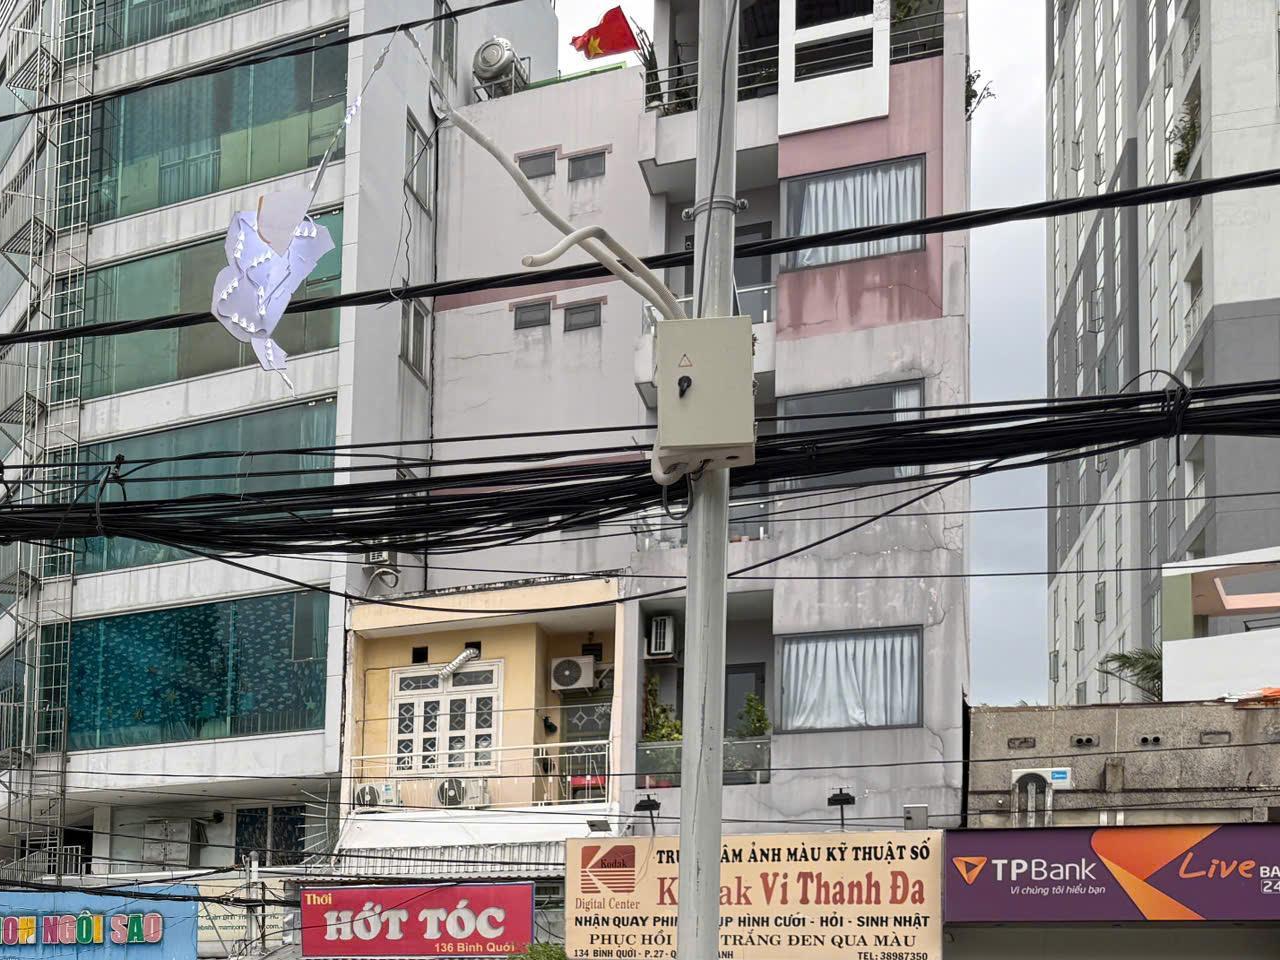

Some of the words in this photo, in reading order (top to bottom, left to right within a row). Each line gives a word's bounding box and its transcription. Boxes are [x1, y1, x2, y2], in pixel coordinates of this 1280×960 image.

[656, 850, 679, 864] TRU
[720, 844, 743, 863] ÂM
[747, 841, 782, 862] ẢNH
[787, 842, 821, 862] MÀU
[825, 842, 848, 862] KỸ
[852, 841, 906, 864] THUẬT
[910, 837, 931, 860] SỐ
[600, 858, 628, 869] Kodak
[991, 858, 1097, 881] TPBank
[1179, 852, 1256, 879] Live
[656, 876, 752, 906] Kak
[760, 871, 789, 905] Vi
[797, 871, 881, 905] Thanh
[889, 870, 925, 905] Đa
[575, 897, 606, 912] Digital
[608, 898, 641, 910] Center
[42, 910, 104, 945] NGÔI
[110, 912, 163, 944] SAO
[323, 901, 409, 941] HỚT
[418, 899, 506, 940] TÓC
[574, 914, 610, 929] NHẬN
[612, 916, 648, 927] QUAY
[738, 913, 770, 928] HÌNH
[820, 912, 844, 927] HỎI
[856, 916, 889, 928] SINH
[893, 913, 930, 930] NHẬT
[434, 943, 454, 953] 136
[589, 934, 637, 947] PHỤC
[641, 930, 673, 946] HỒI
[721, 928, 781, 946] TRẮNG
[787, 934, 826, 946] ĐEN
[831, 934, 868, 949] QUA
[874, 932, 916, 947] MÀU
[574, 949, 589, 958] 134
[593, 947, 613, 957] BÌNH
